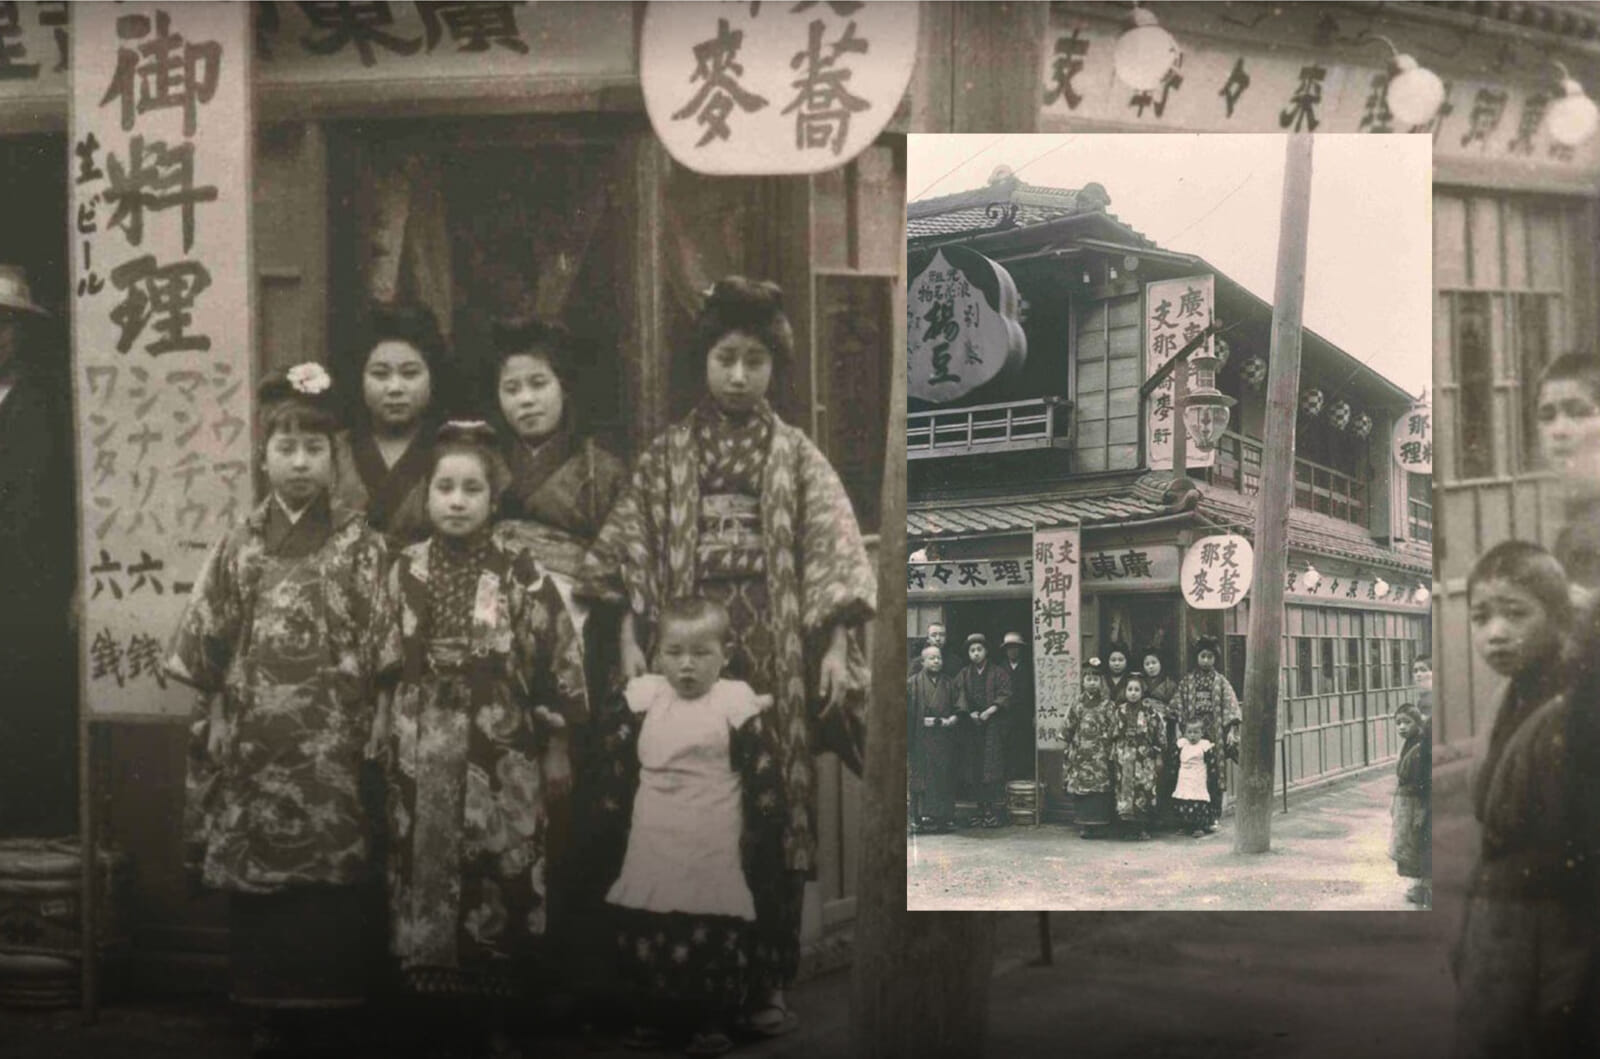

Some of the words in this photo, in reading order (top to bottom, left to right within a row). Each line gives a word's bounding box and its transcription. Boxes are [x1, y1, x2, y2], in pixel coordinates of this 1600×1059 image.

[75, 131, 104, 297] 生ビール
[100, 9, 223, 356] 御料理
[1040, 566, 1072, 656] 御料理
